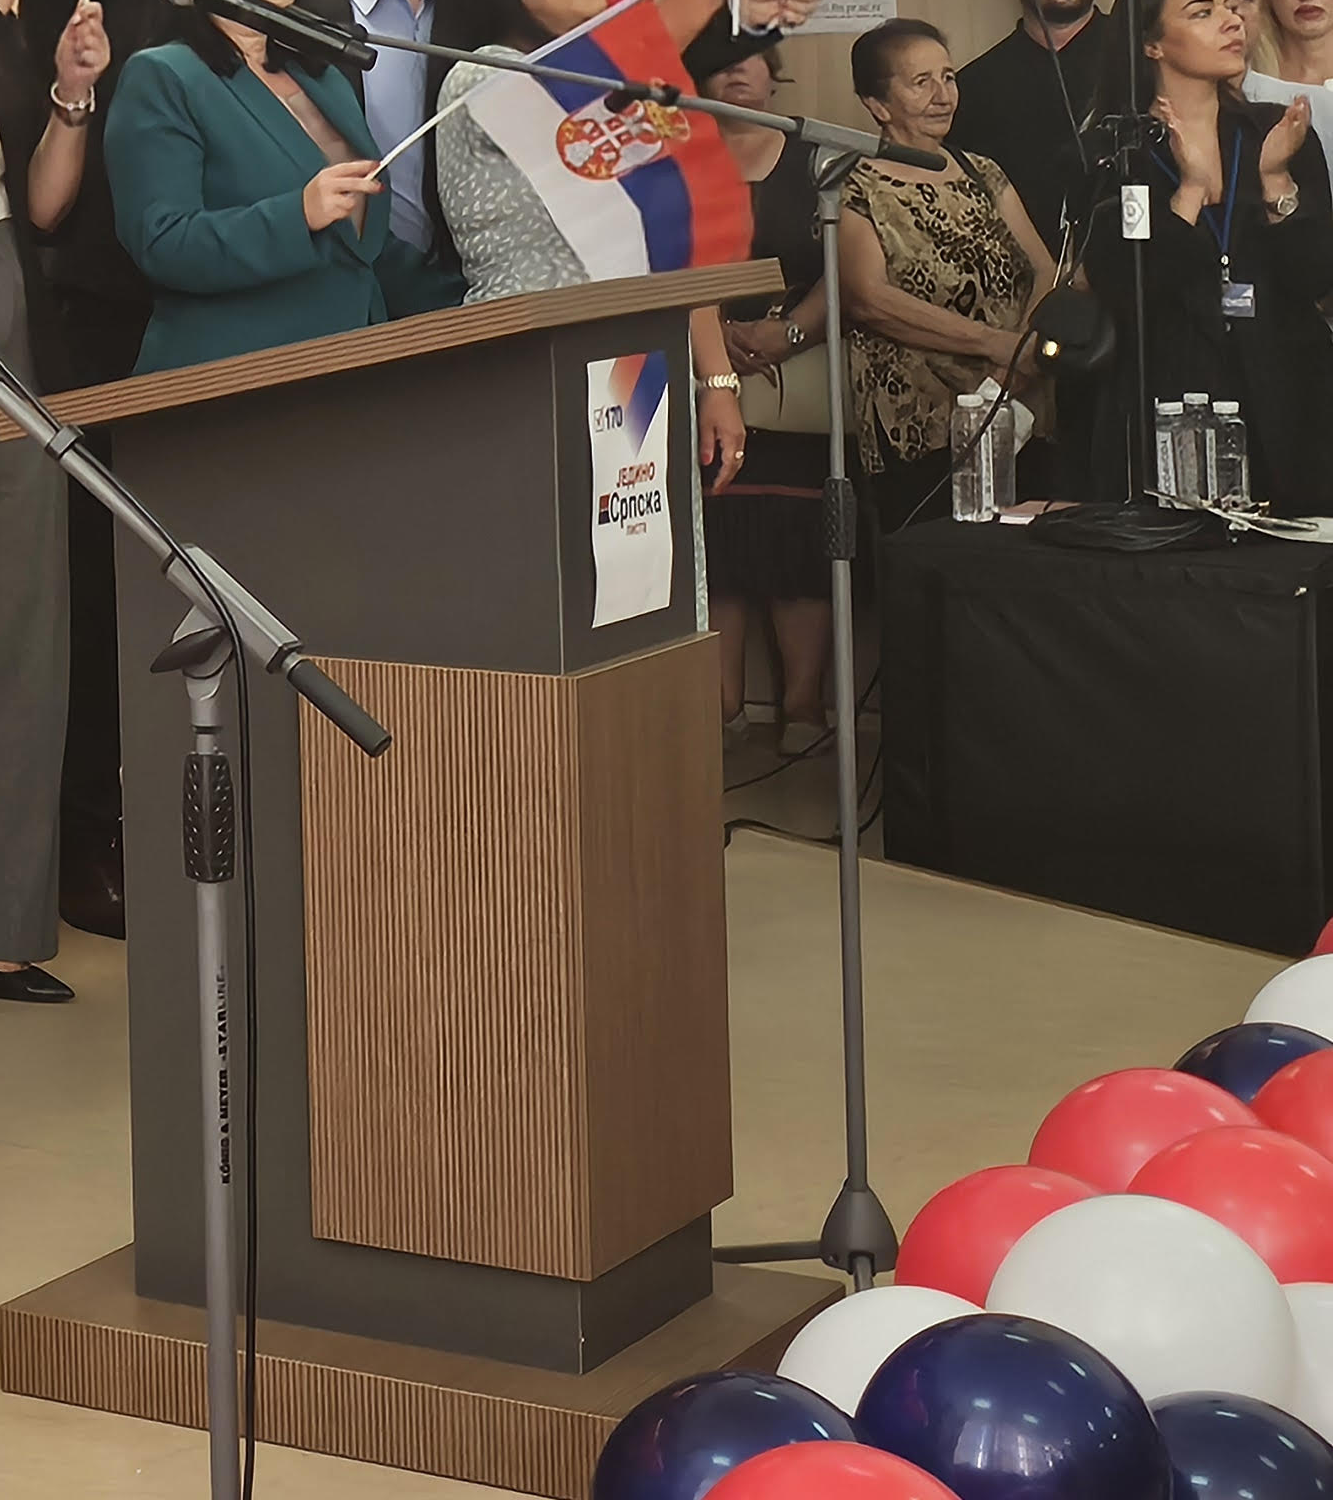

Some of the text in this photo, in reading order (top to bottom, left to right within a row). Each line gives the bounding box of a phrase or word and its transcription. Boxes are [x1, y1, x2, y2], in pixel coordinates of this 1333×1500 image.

[605, 405, 623, 430] 170
[617, 461, 655, 490] ЈЕДИНО
[610, 489, 662, 529] Српска
[218, 1070, 228, 1119] MEYER
